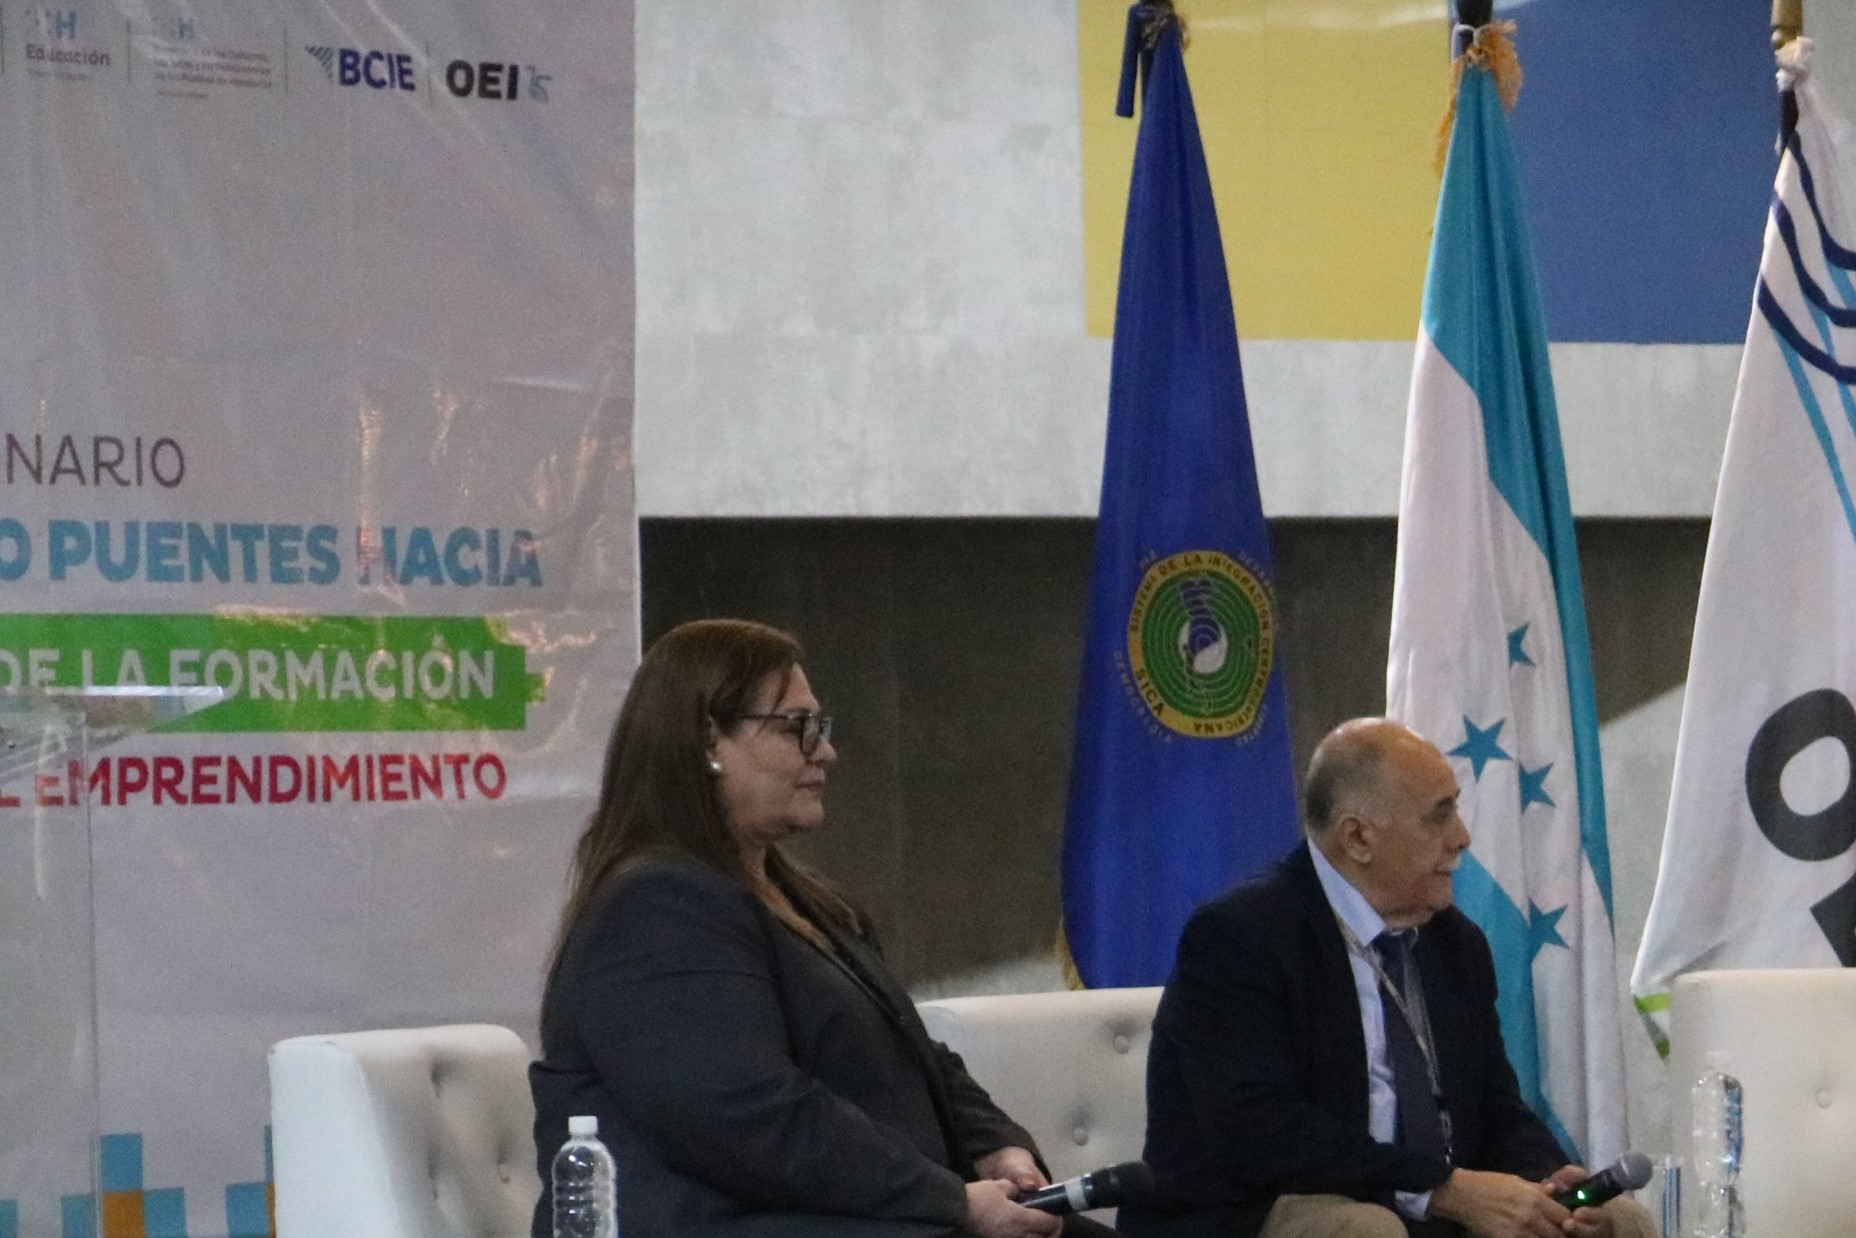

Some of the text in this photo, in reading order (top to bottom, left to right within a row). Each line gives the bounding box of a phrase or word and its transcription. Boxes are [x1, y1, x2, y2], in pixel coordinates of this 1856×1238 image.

[338, 47, 416, 91] BCIE
[446, 59, 520, 101] OEI
[48, 520, 341, 585] PUENTES
[357, 525, 544, 587] HACIA
[82, 649, 148, 693] LA
[169, 634, 496, 701] FORMACIÓN
[1134, 667, 1165, 716] SICA
[35, 752, 508, 807] EMPRENDIMIENTO
